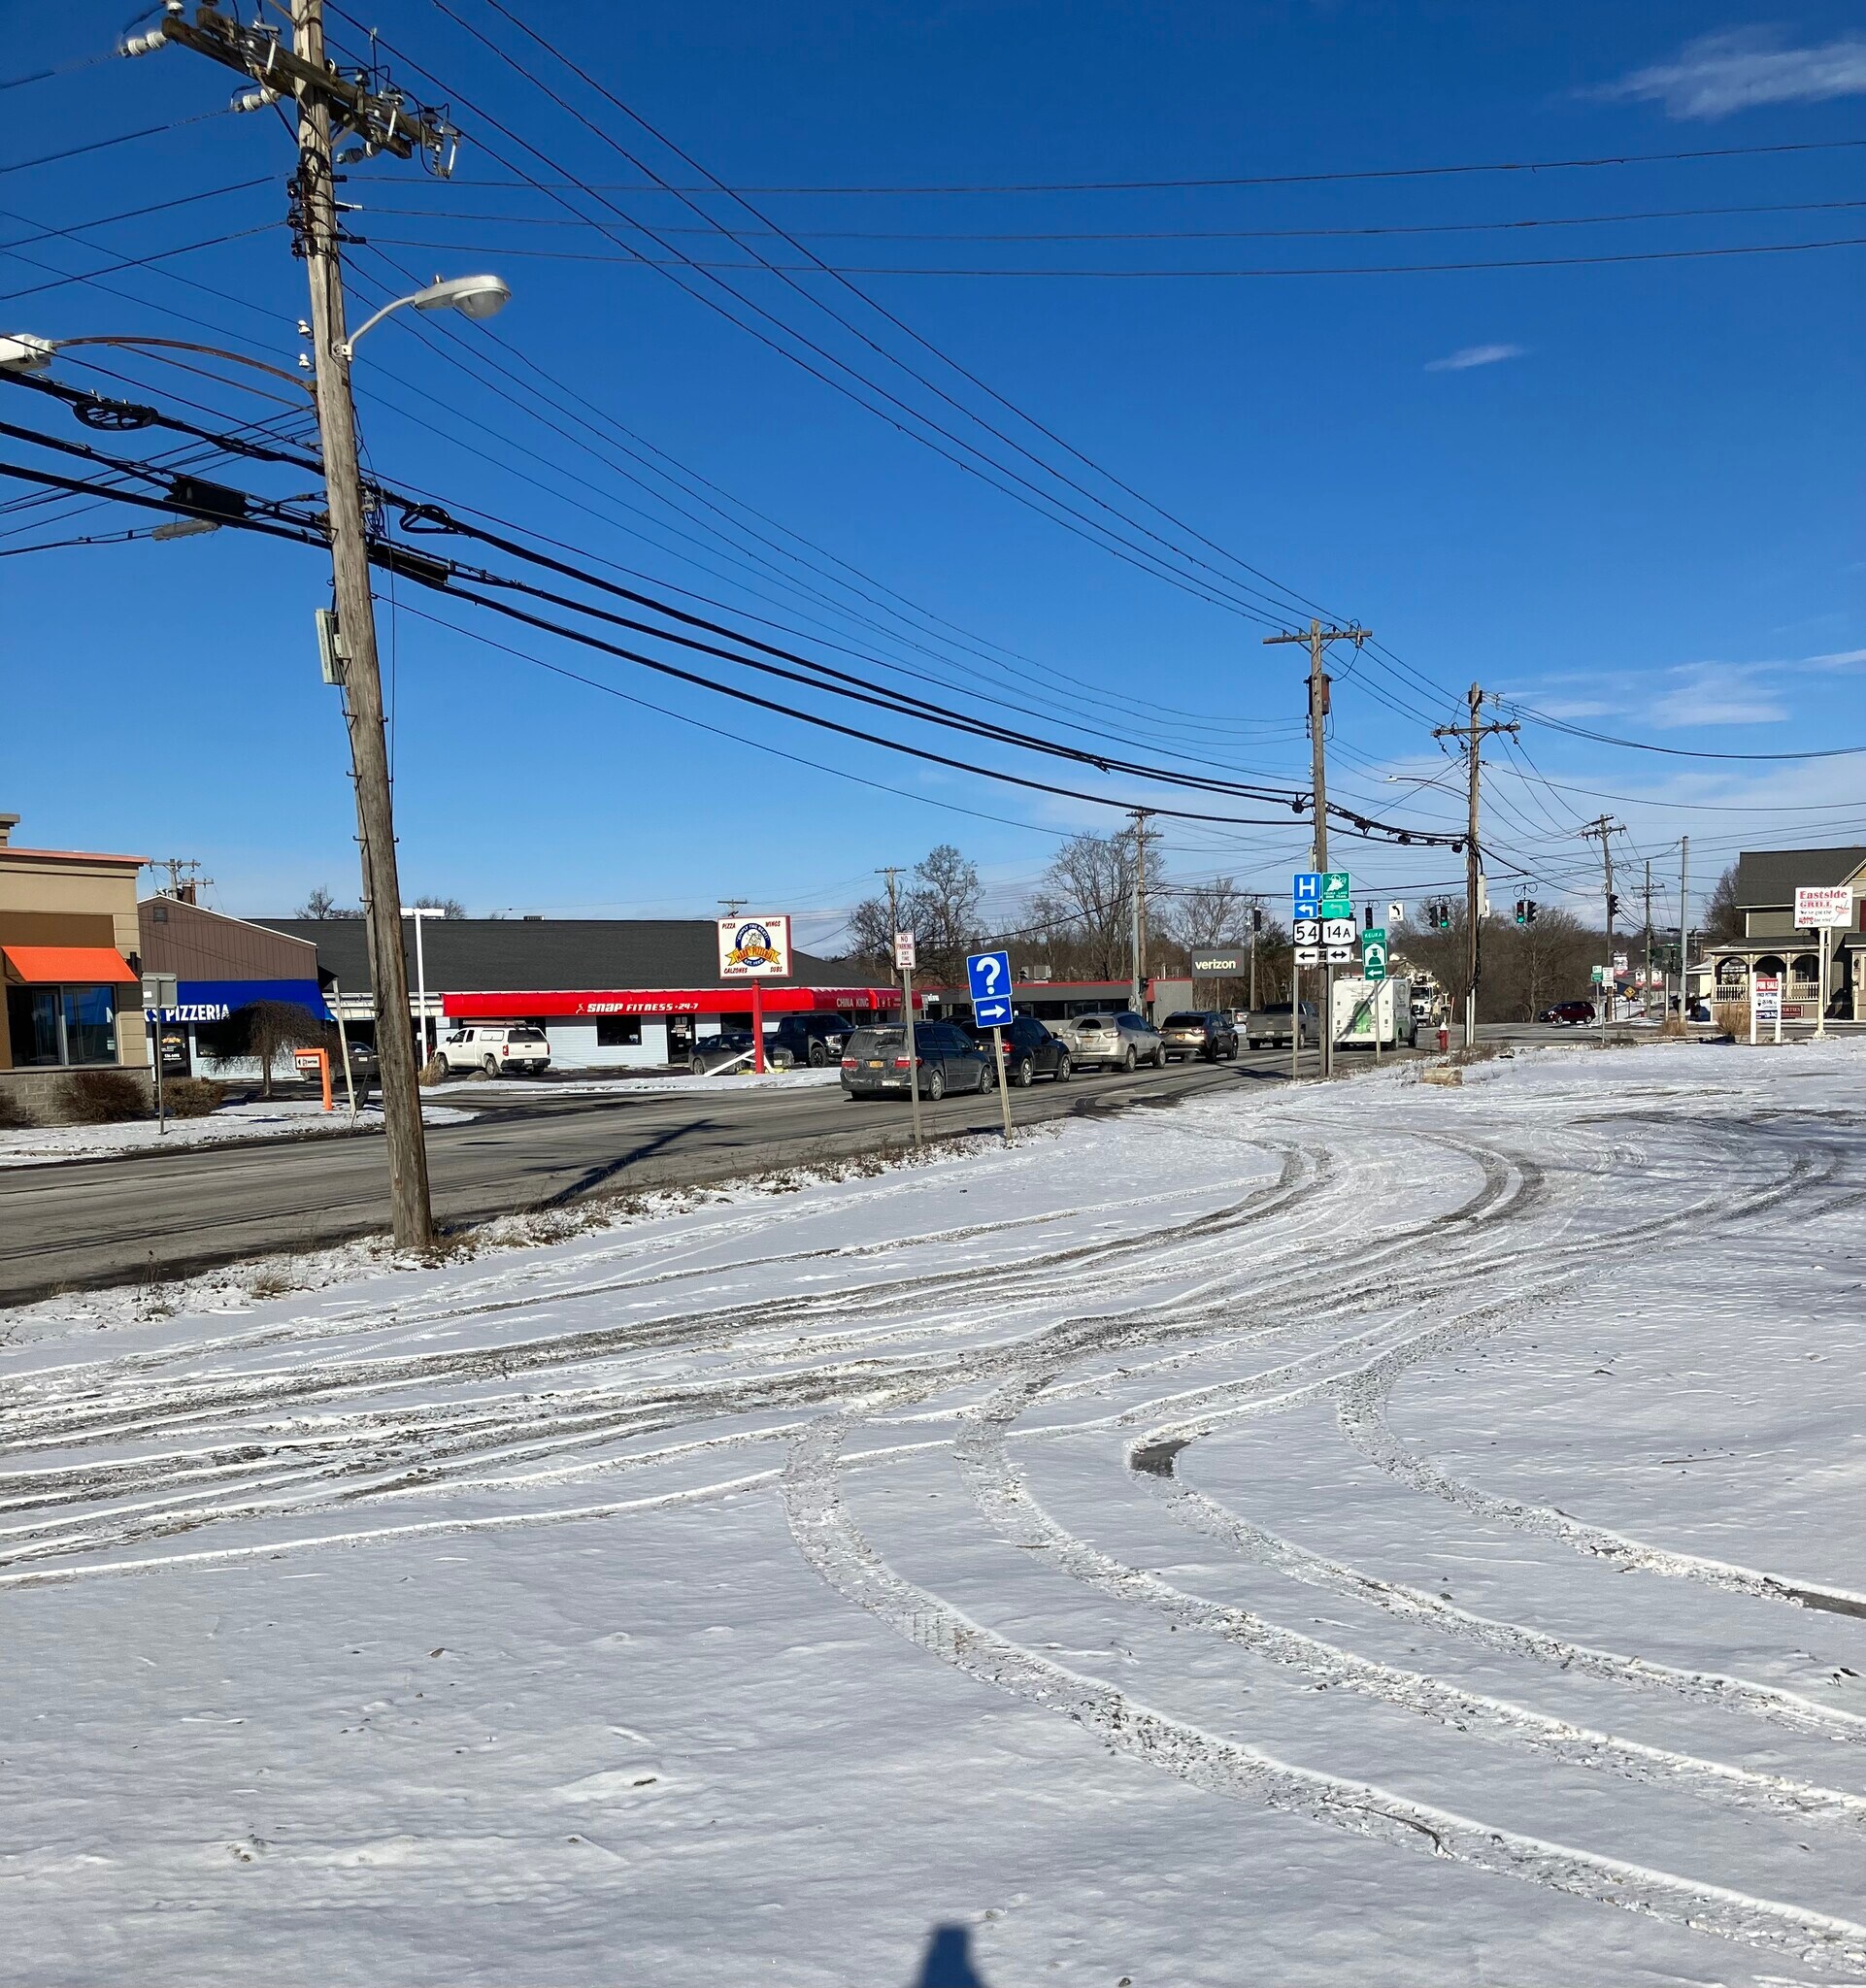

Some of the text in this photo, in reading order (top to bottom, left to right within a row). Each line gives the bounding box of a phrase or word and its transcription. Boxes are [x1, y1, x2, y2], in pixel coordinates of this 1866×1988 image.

[1298, 877, 1316, 897] H
[1800, 890, 1848, 899] Eastside
[1296, 925, 1317, 941] 54
[1327, 925, 1351, 939] 14A
[1195, 958, 1236, 970] verizon
[1757, 980, 1778, 989] FOR SALE
[625, 1003, 674, 1012] FITNESS
[836, 997, 854, 1008] CHINA
[855, 997, 869, 1008] KING
[165, 1004, 230, 1022] PIZZERIA
